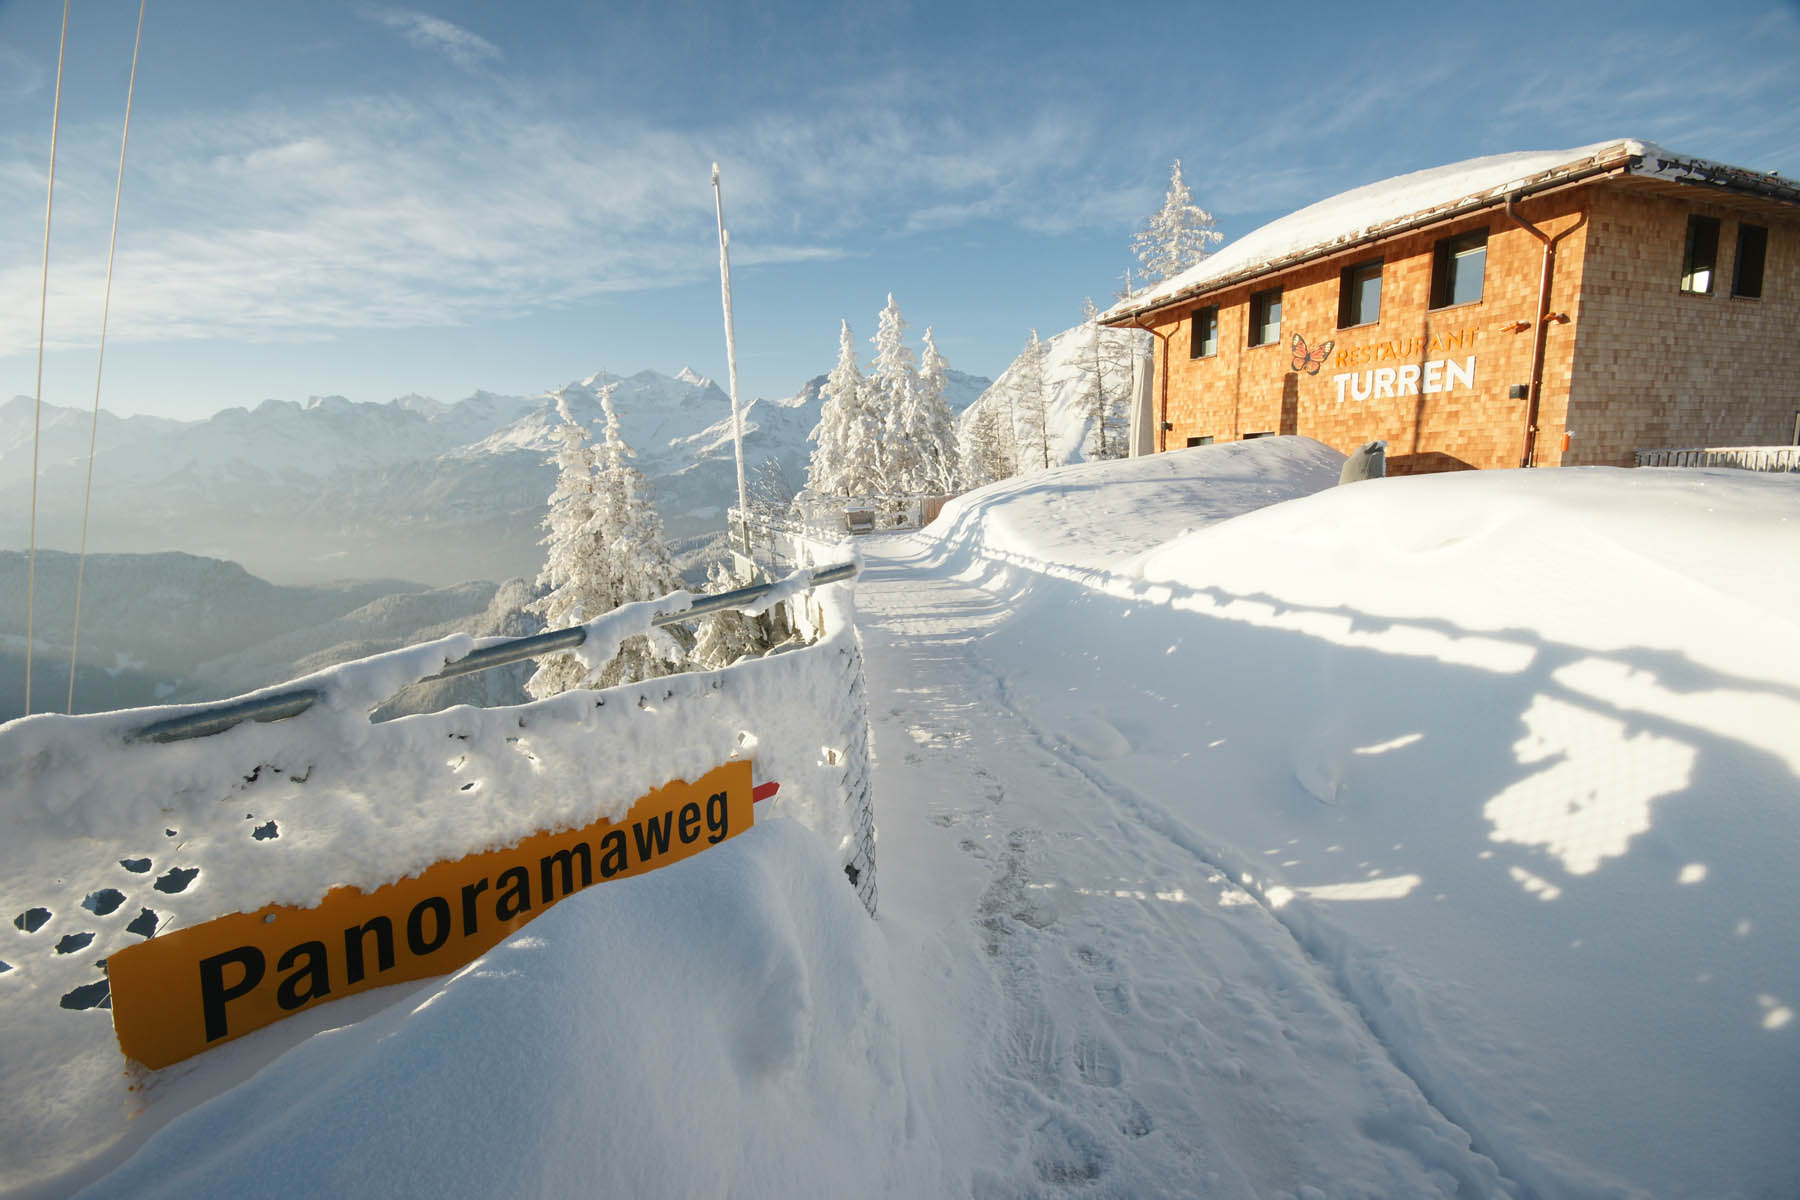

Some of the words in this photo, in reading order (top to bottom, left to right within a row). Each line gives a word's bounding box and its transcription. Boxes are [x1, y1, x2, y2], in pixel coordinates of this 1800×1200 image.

[1335, 327, 1478, 368] RESTAURANT
[1333, 354, 1475, 403] TURREN
[199, 790, 729, 1043] Panoramaweg
